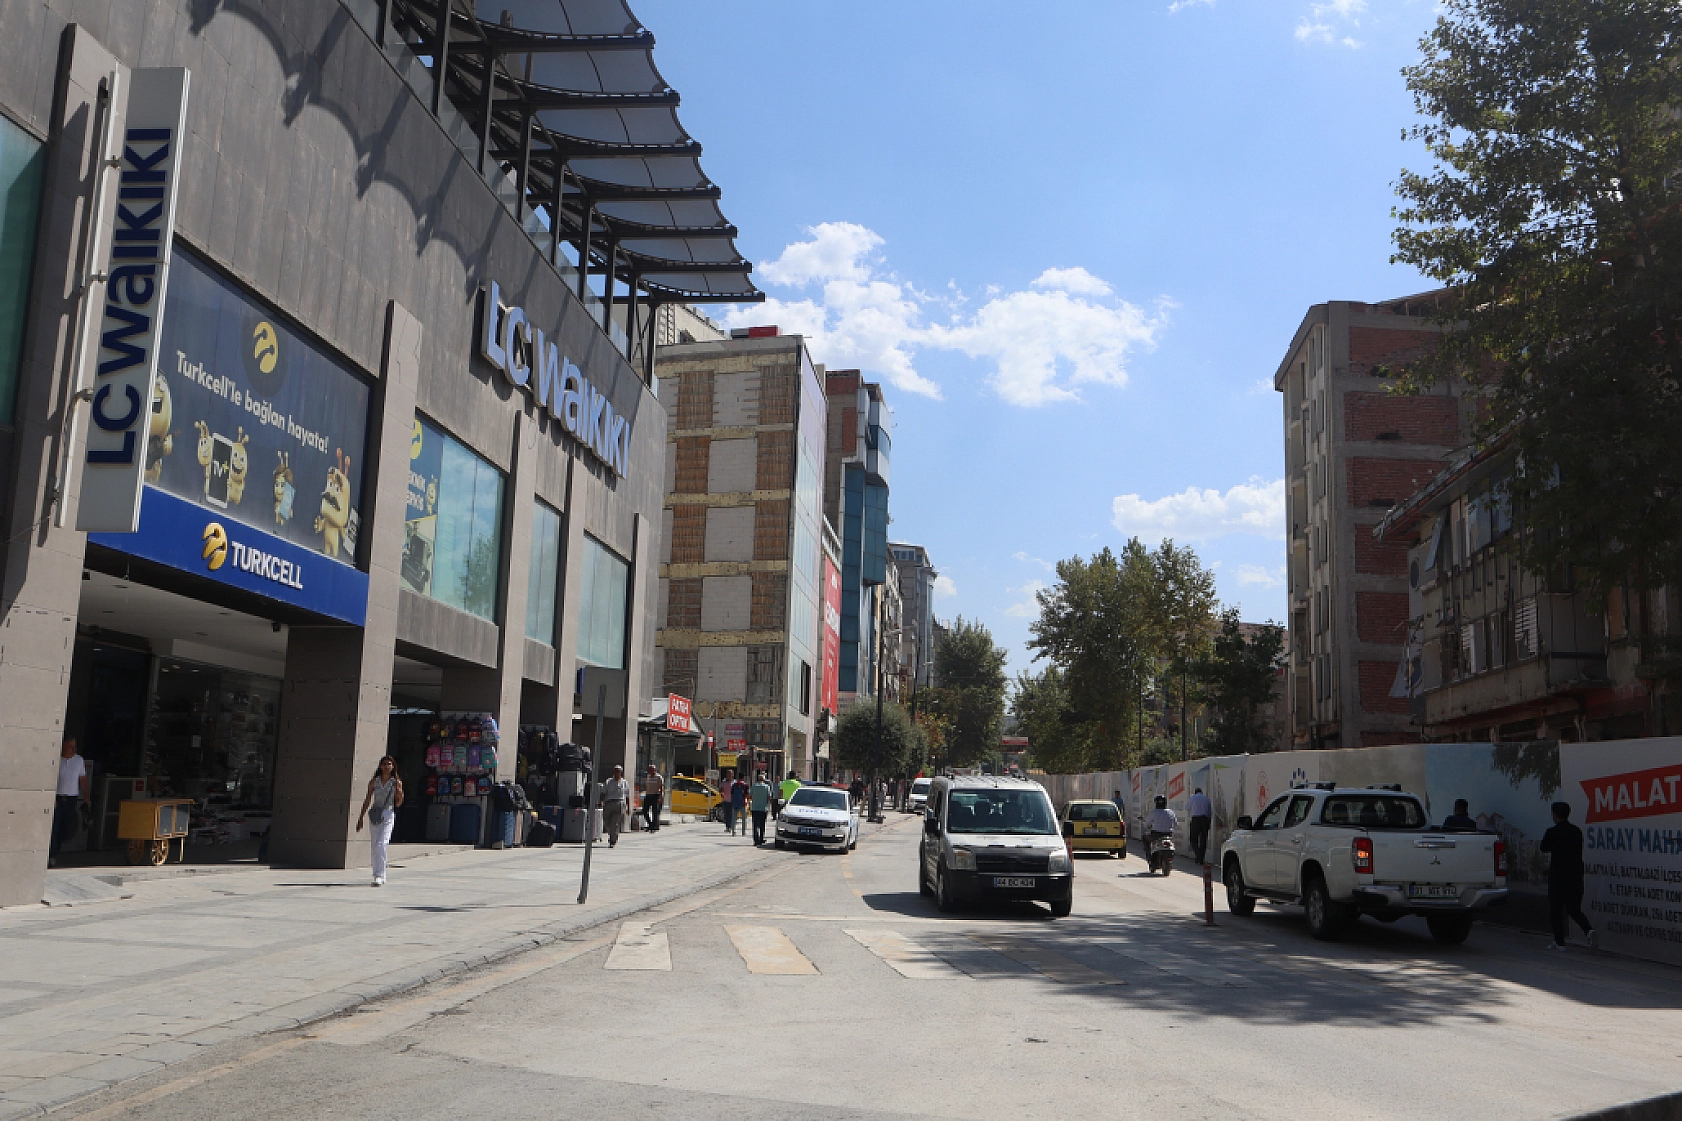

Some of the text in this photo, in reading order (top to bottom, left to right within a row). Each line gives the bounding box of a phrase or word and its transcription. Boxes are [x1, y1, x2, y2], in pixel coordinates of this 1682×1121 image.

[176, 350, 330, 454] Turkcell'le bağlan hayata!
[231, 541, 303, 590] TURKCELL
[1586, 827, 1633, 852] SARAY
